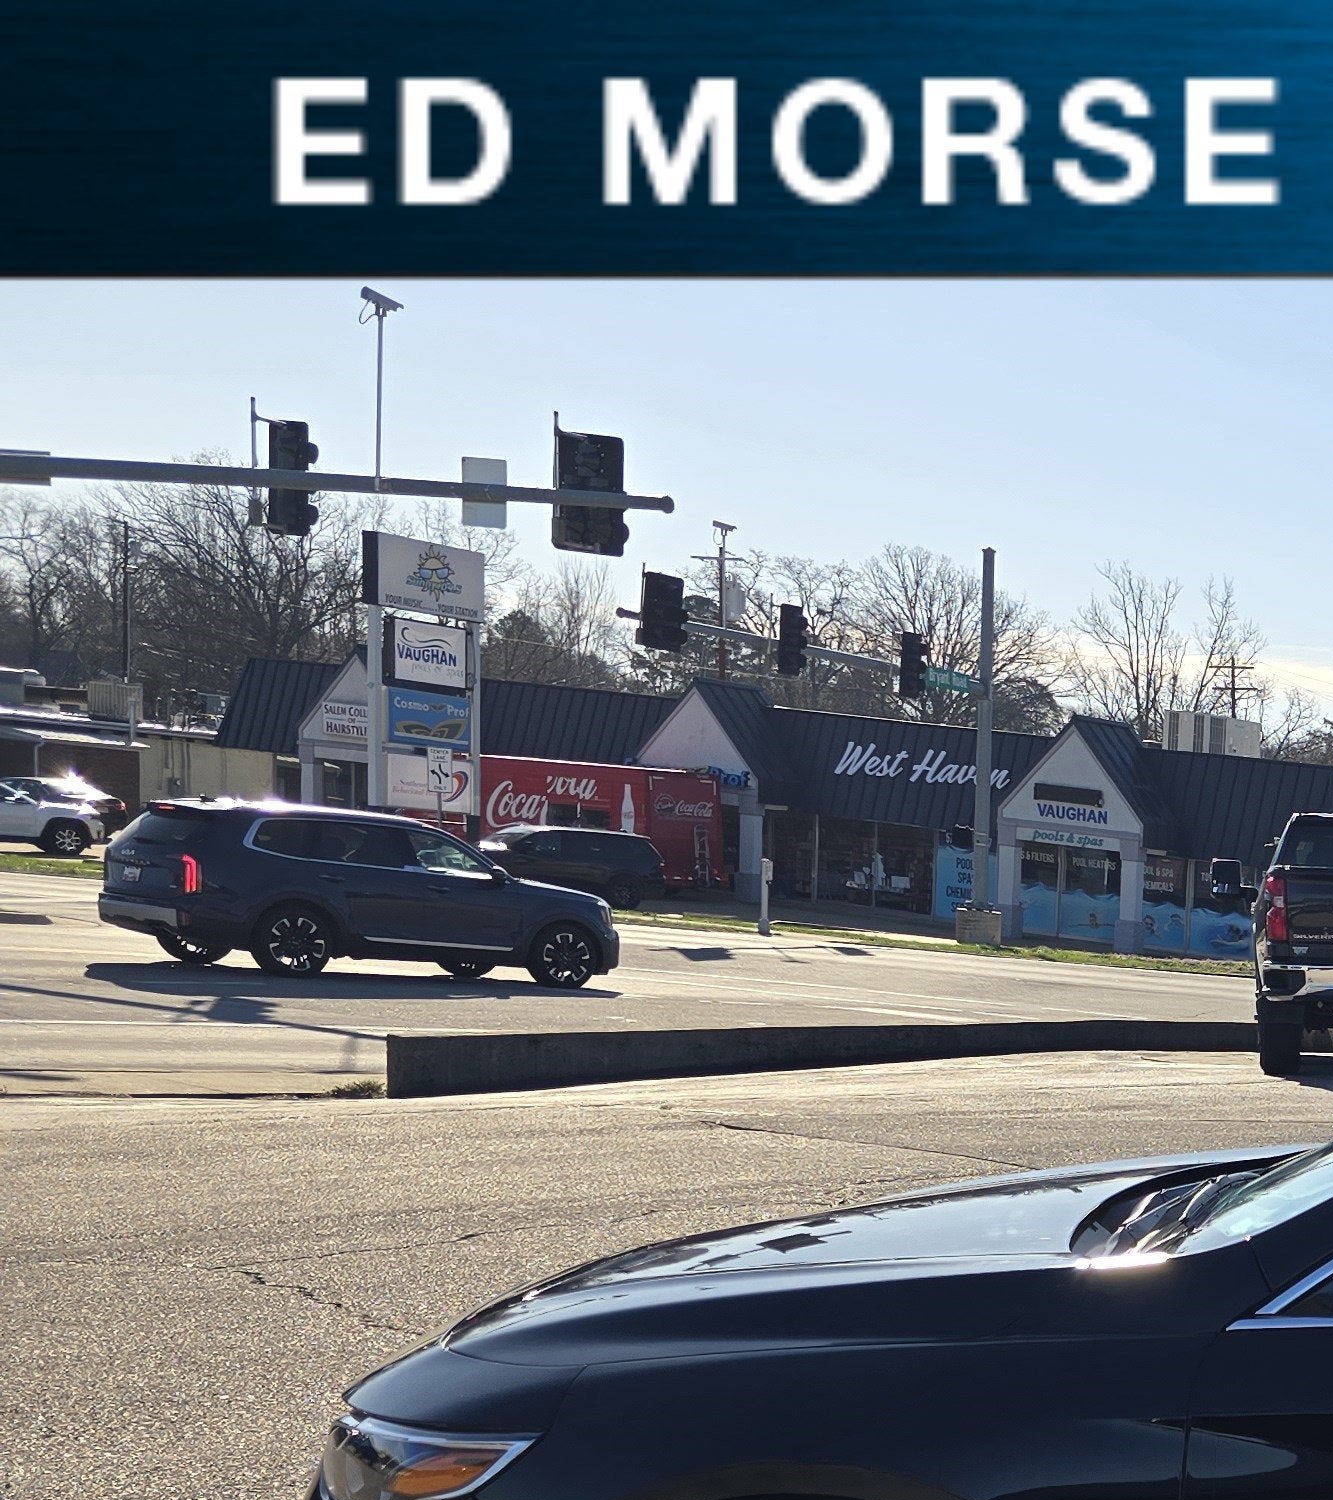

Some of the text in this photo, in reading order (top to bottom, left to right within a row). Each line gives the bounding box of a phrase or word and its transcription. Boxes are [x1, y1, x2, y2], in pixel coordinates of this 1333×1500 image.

[397, 642, 457, 667] VAUGHAN
[350, 706, 369, 719] COLL
[394, 697, 429, 712] Cosmo
[326, 721, 368, 737] HAIRSTYLI
[834, 741, 1011, 790] West Havn
[1037, 802, 1108, 825] VAUGHAN
[1032, 828, 1104, 848] pools & spas
[957, 871, 973, 885] SPA
[1144, 881, 1174, 893] HEMICALS
